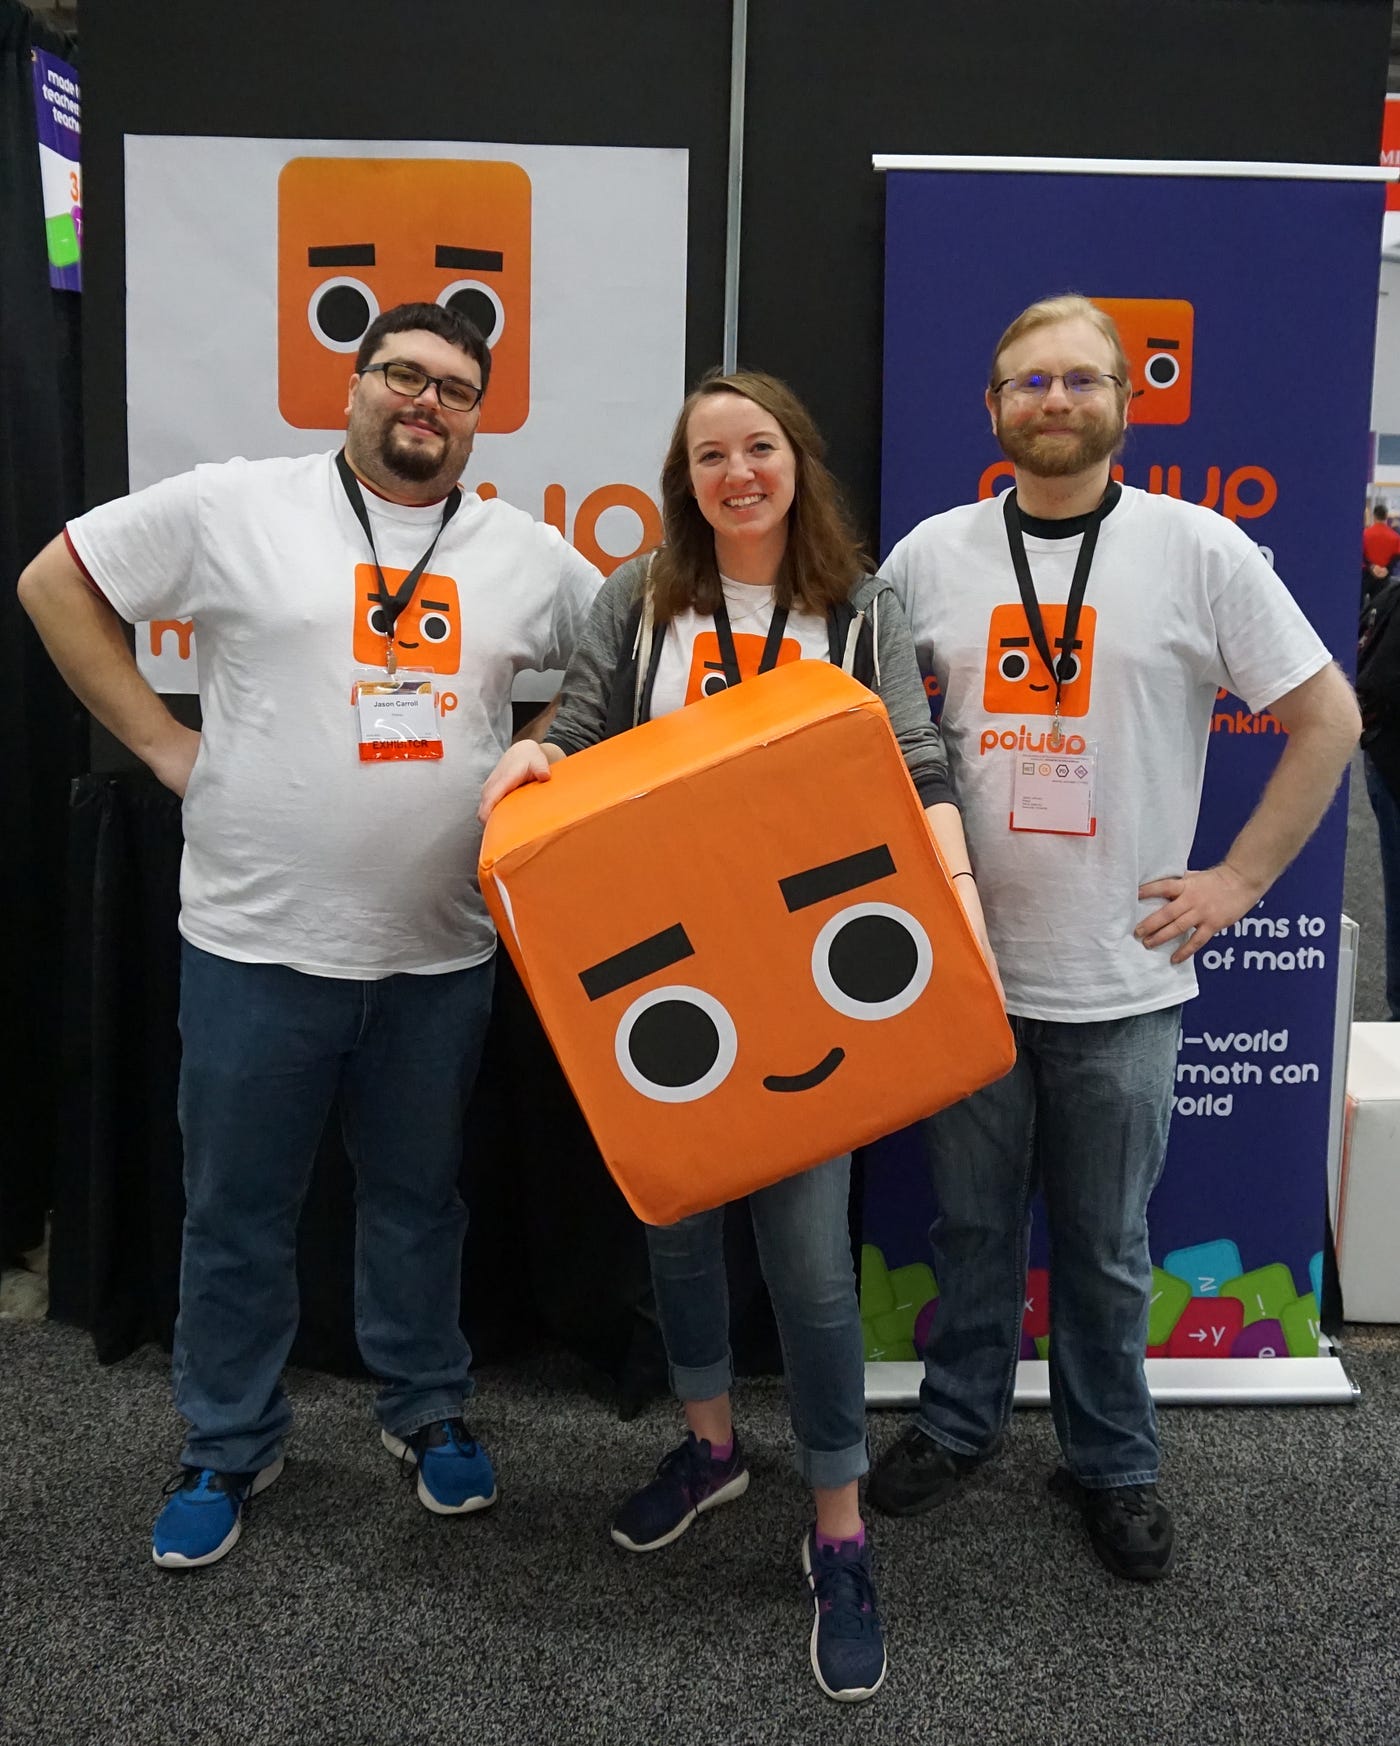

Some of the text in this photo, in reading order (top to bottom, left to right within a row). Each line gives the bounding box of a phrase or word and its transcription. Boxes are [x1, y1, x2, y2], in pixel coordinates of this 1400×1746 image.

[47, 69, 75, 96] made
[395, 700, 419, 708] Carroll
[1297, 914, 1325, 937] to
[1202, 946, 1325, 970] of math
[1177, 1029, 1289, 1052] l-world
[1176, 1062, 1320, 1085] math can
